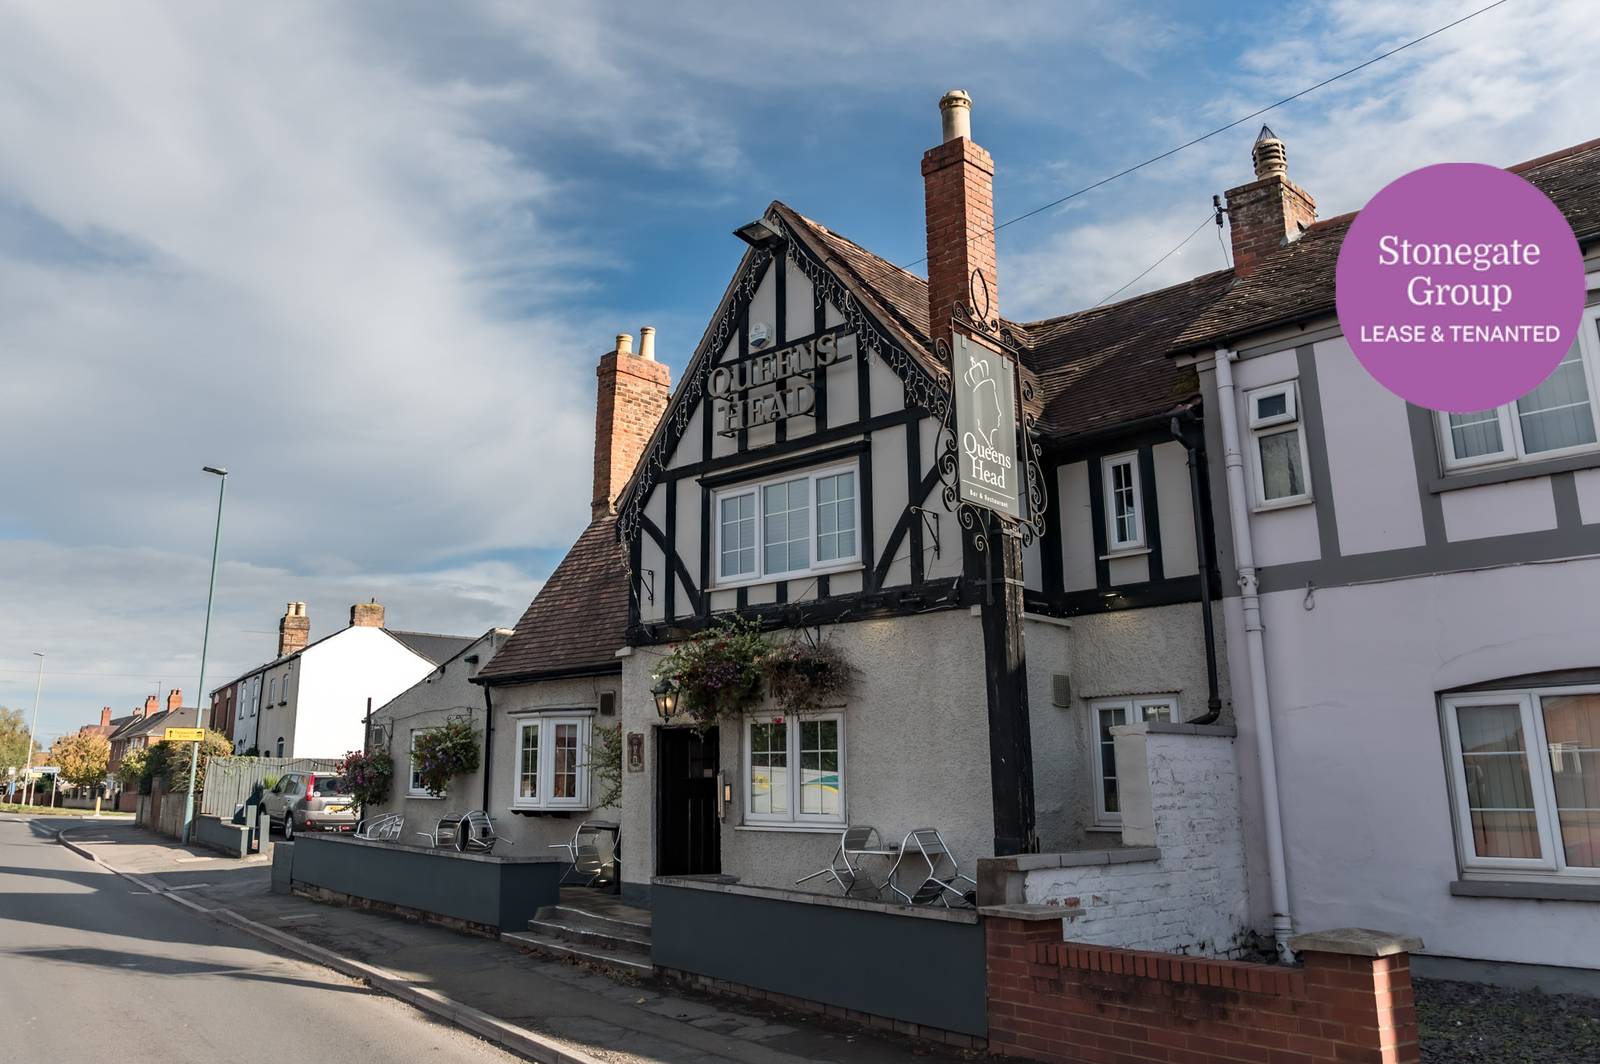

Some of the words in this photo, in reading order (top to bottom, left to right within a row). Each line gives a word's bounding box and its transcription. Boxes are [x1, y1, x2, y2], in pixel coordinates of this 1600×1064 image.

[708, 332, 837, 401] QUEENS
[718, 382, 816, 434] HEAD
[963, 431, 1012, 469] Queens
[972, 457, 1007, 489] Head
